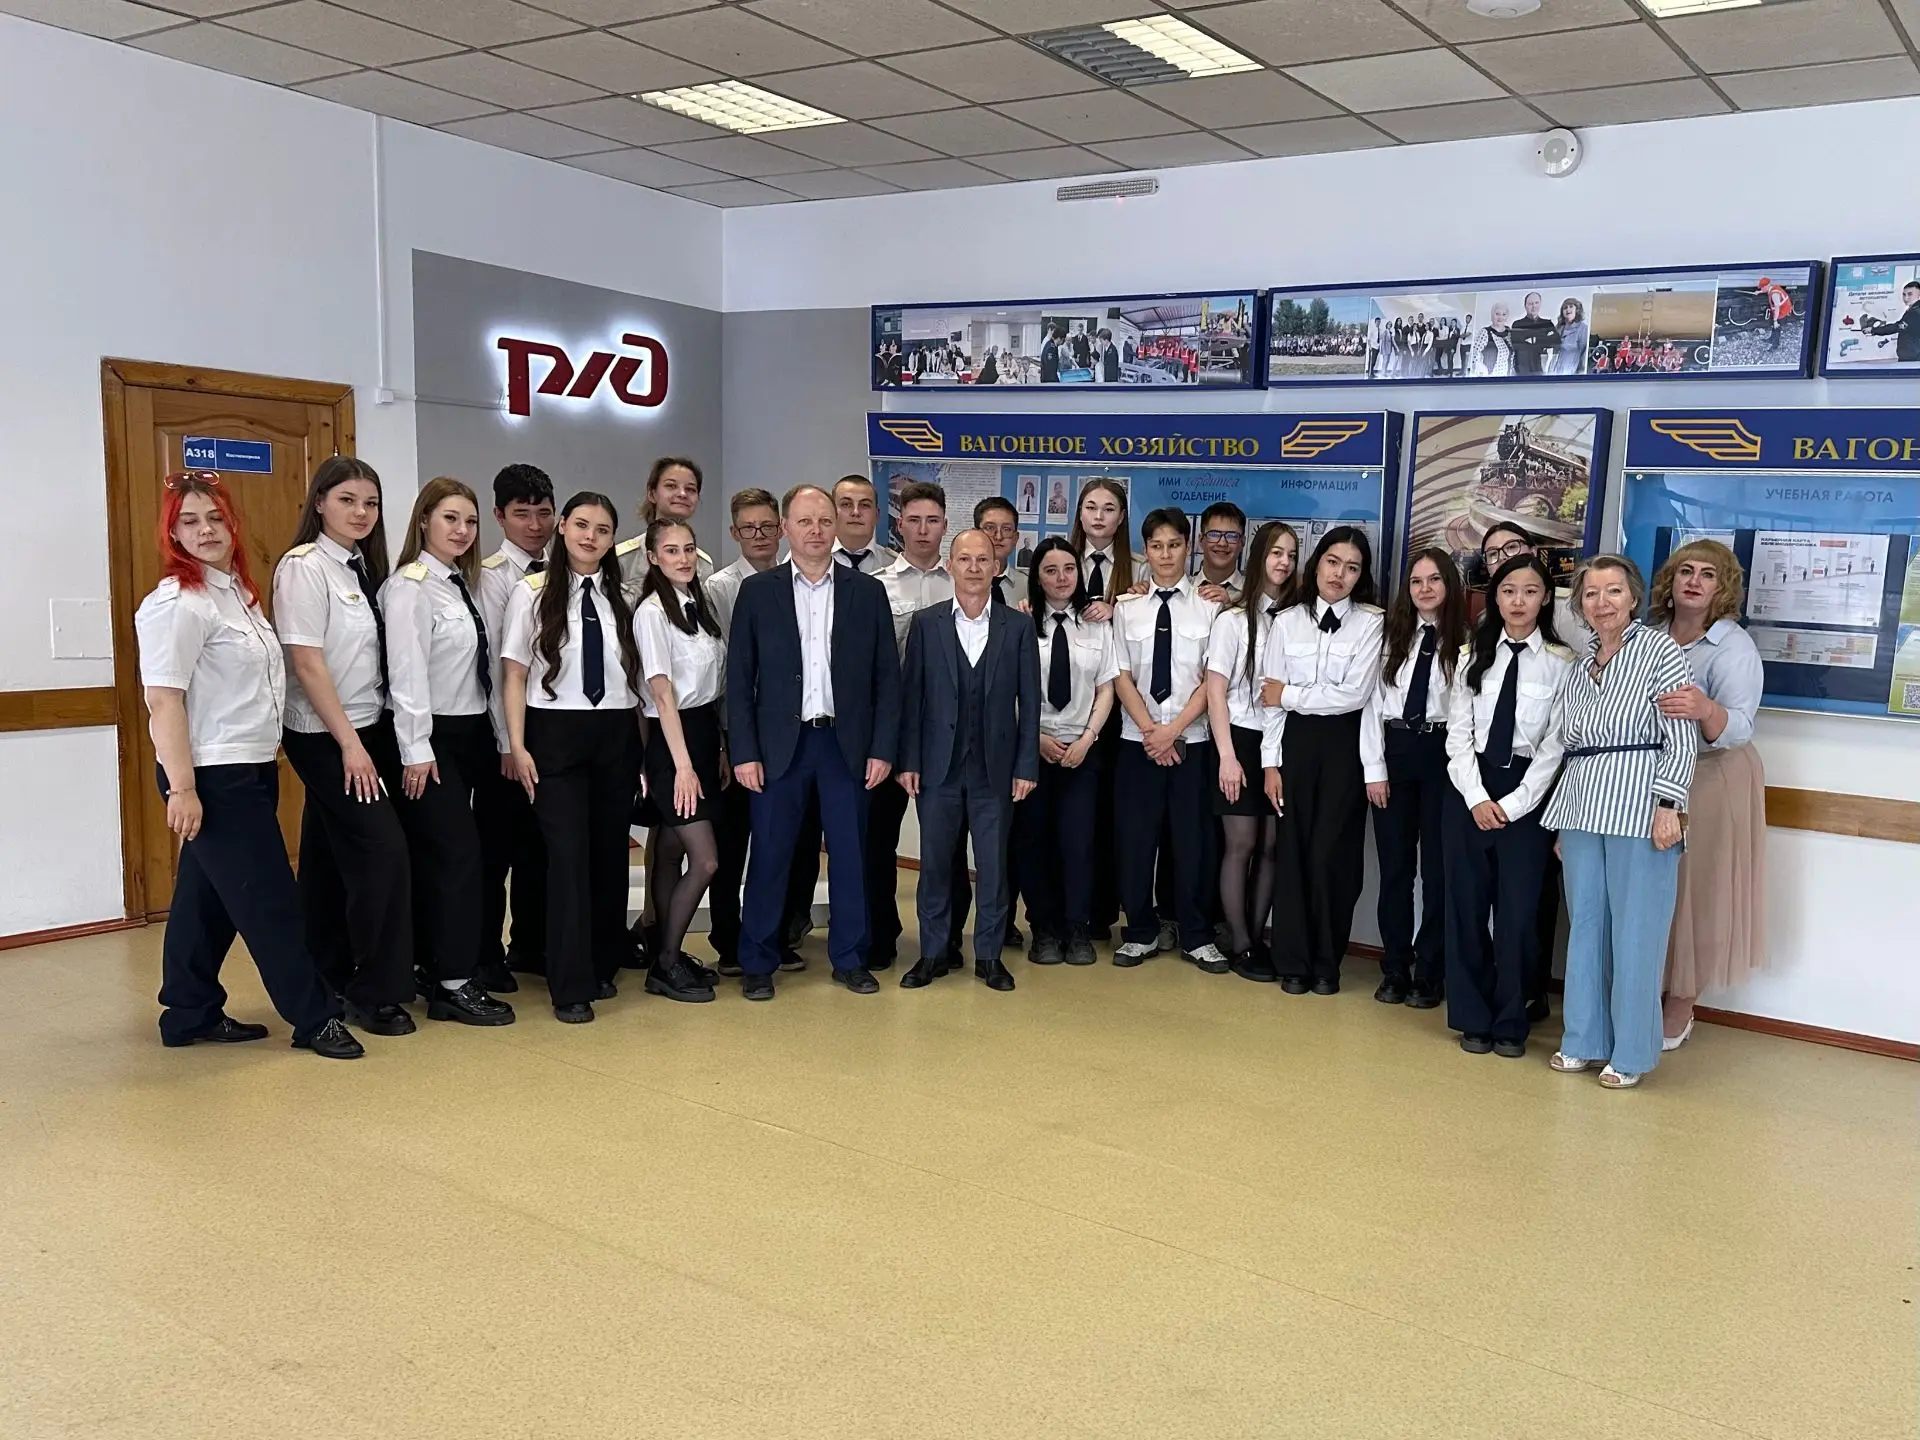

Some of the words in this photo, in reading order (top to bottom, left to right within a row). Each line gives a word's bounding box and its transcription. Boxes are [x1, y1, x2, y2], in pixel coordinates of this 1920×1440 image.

[959, 434, 1087, 455] ВАГОННОЕ
[1099, 432, 1260, 457] ХОЗЯЙСТВО
[1158, 476, 1181, 487] ИМИ
[1280, 479, 1359, 491] ИНФОРМАЦИЯ
[1171, 490, 1228, 502] ОТДЕЛЕНИЕ
[1765, 488, 1830, 501] УЧЕБНАЯ
